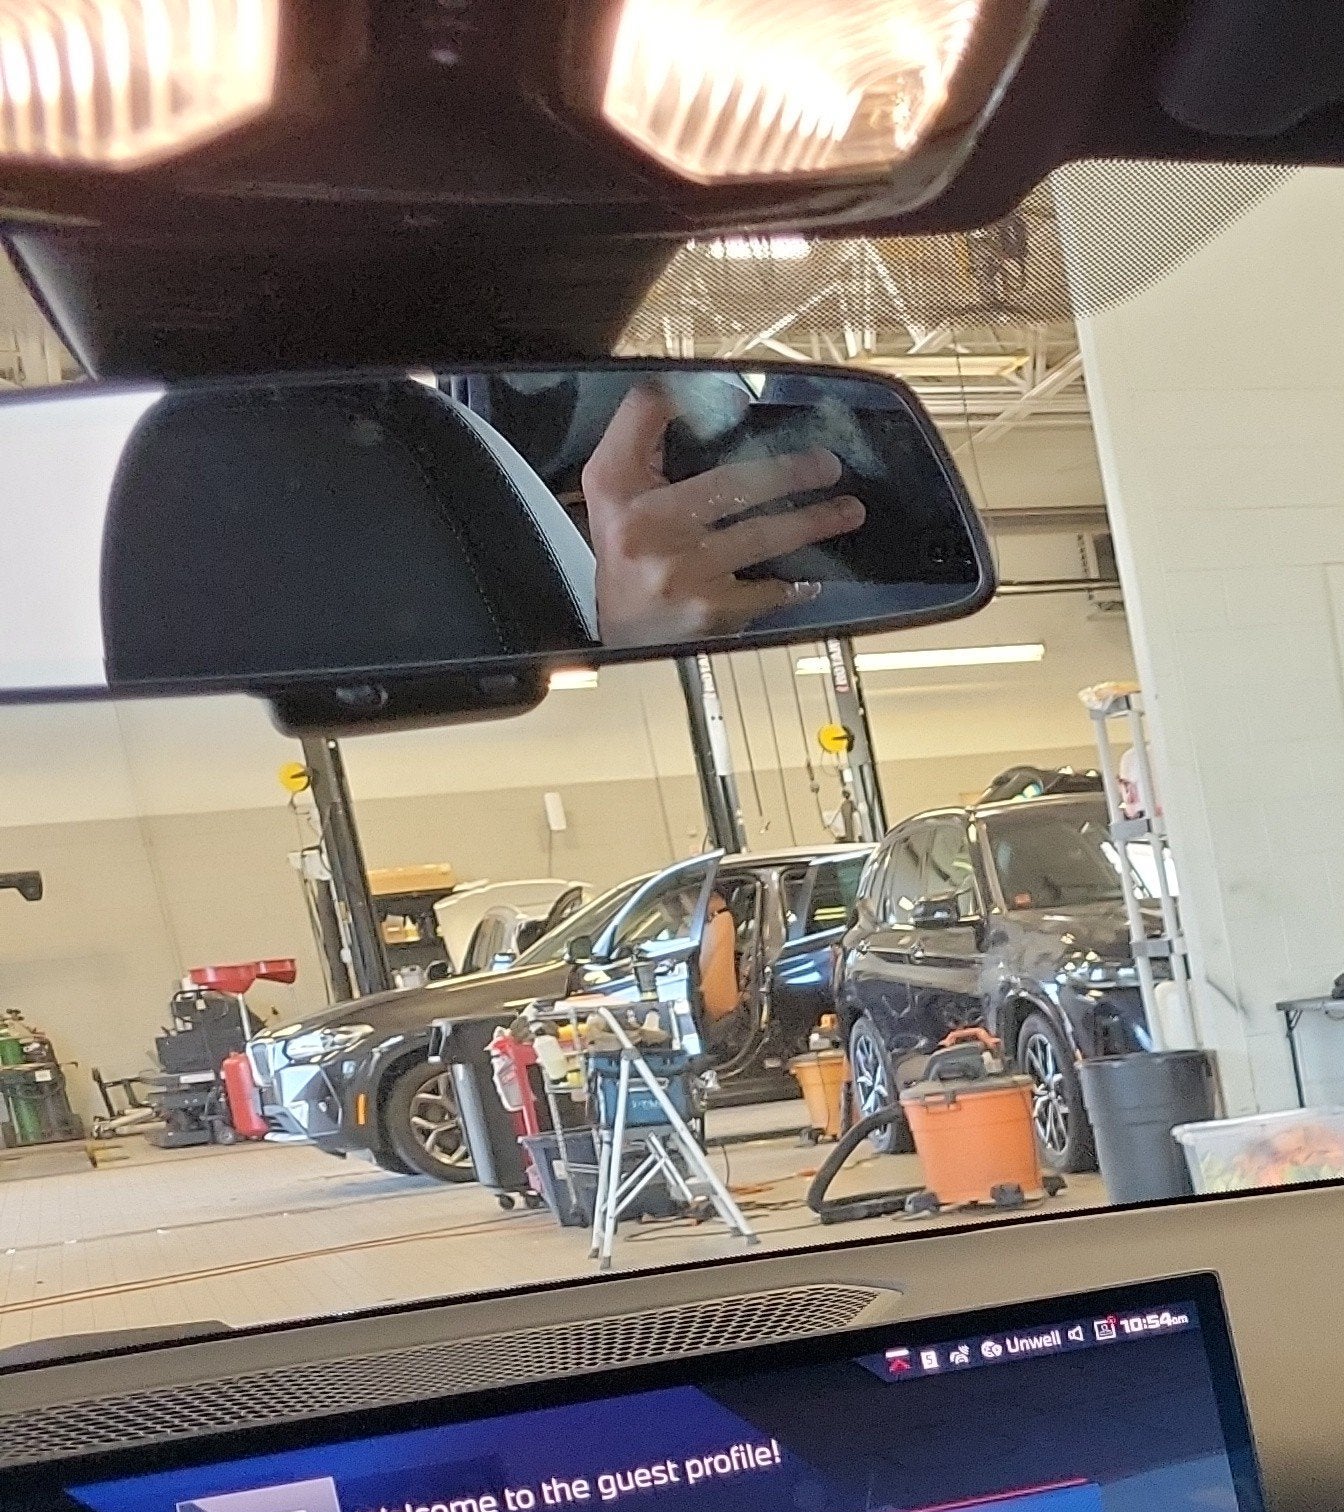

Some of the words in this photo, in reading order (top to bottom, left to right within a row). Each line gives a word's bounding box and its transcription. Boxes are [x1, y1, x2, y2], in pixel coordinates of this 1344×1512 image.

[1119, 1311, 1189, 1334] 10:54am
[504, 1487, 534, 1511] to
[541, 1477, 590, 1506] the
[598, 1459, 679, 1501] guest
[684, 1438, 782, 1485] profile!
